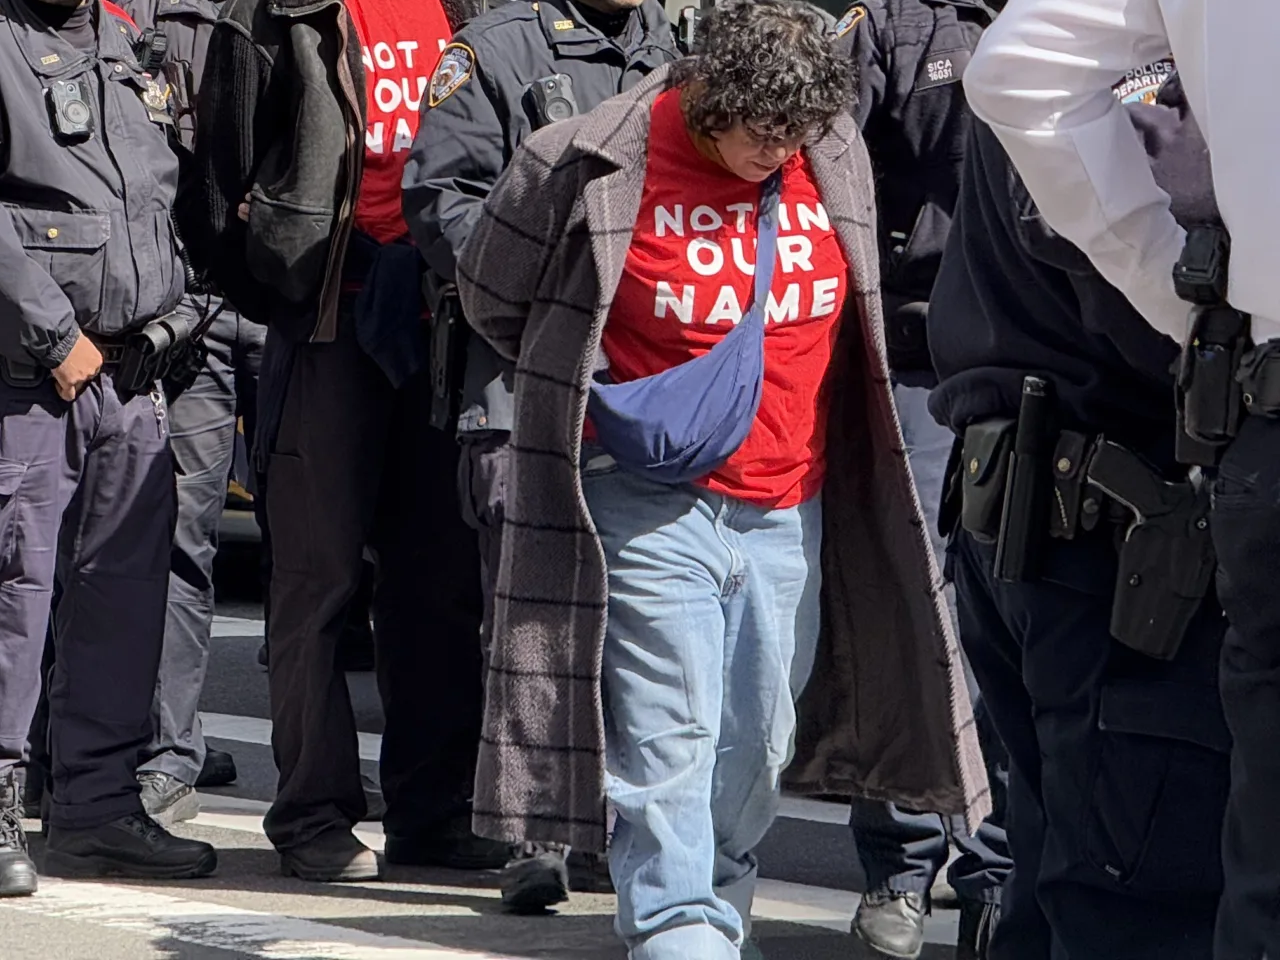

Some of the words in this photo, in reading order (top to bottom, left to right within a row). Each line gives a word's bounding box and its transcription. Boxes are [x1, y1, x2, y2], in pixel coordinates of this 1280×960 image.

[927, 59, 952, 73] SICA
[1125, 62, 1172, 81] POLICE
[374, 76, 427, 113] OU
[365, 118, 413, 154] NA
[654, 203, 753, 237] NOT
[778, 202, 830, 232] IN
[686, 234, 815, 276] OUR
[654, 277, 839, 325] NAME
